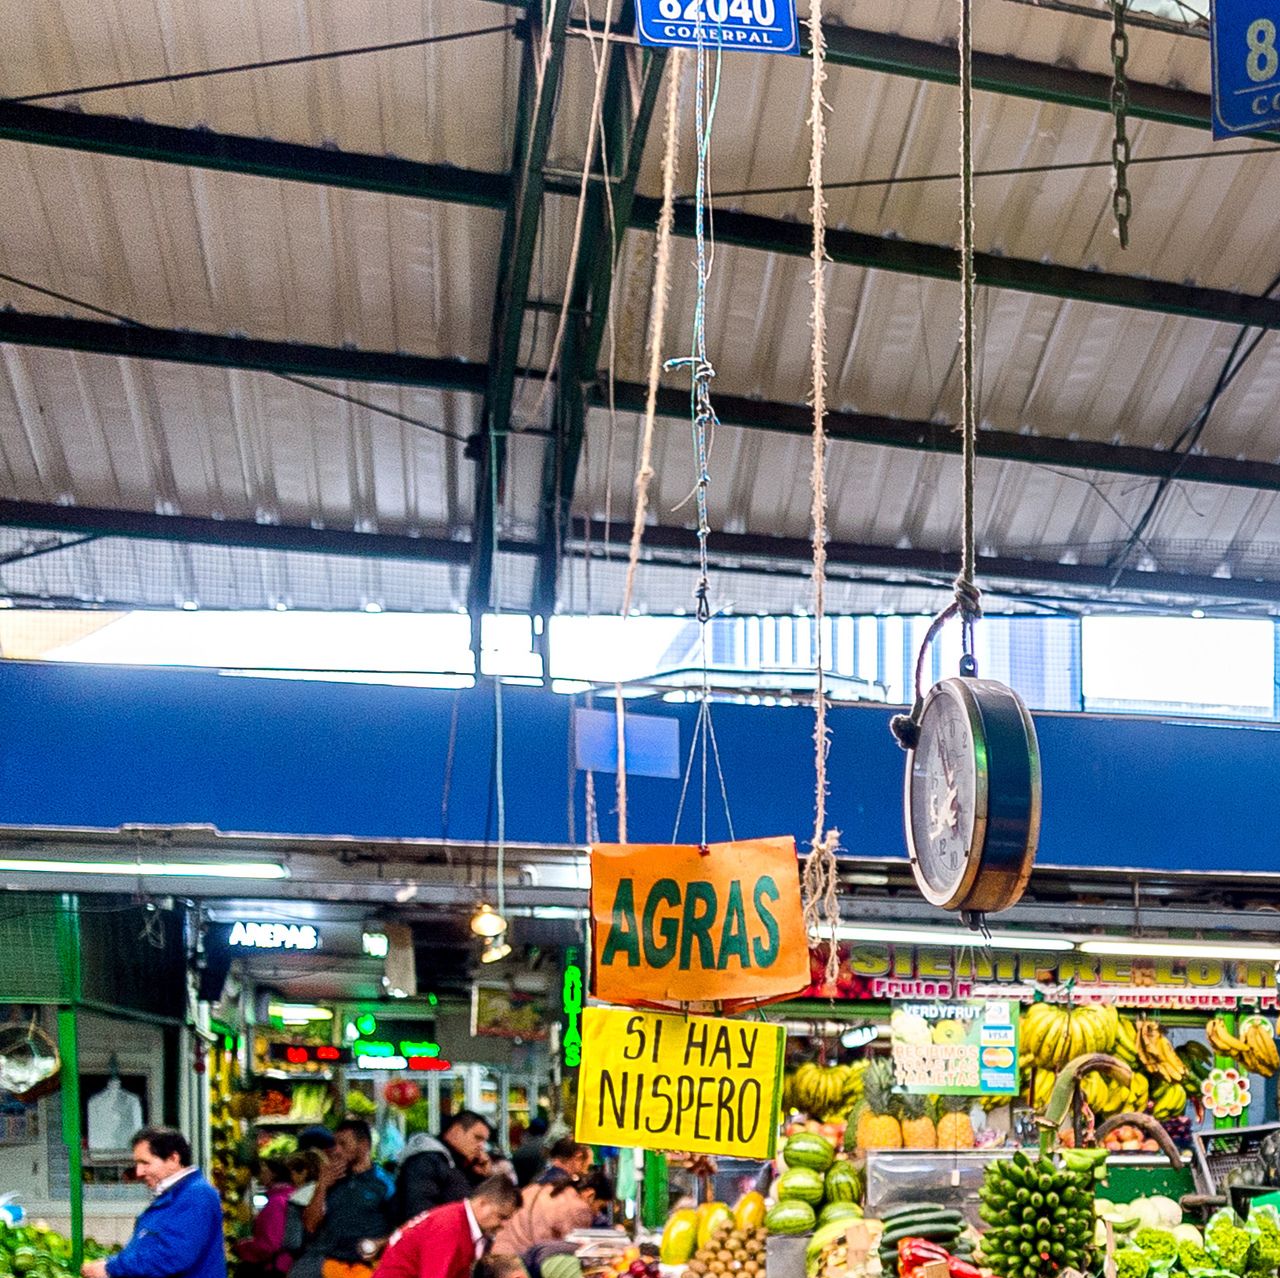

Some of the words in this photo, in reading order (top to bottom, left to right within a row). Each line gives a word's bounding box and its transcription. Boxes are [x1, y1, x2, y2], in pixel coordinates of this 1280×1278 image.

[664, 25, 773, 44] COMERPAL
[601, 875, 780, 970] AGRAS
[873, 978, 950, 999] Frutas
[622, 1016, 662, 1063] SI
[683, 1020, 759, 1070] HAY
[598, 1068, 762, 1144] NISPERO
